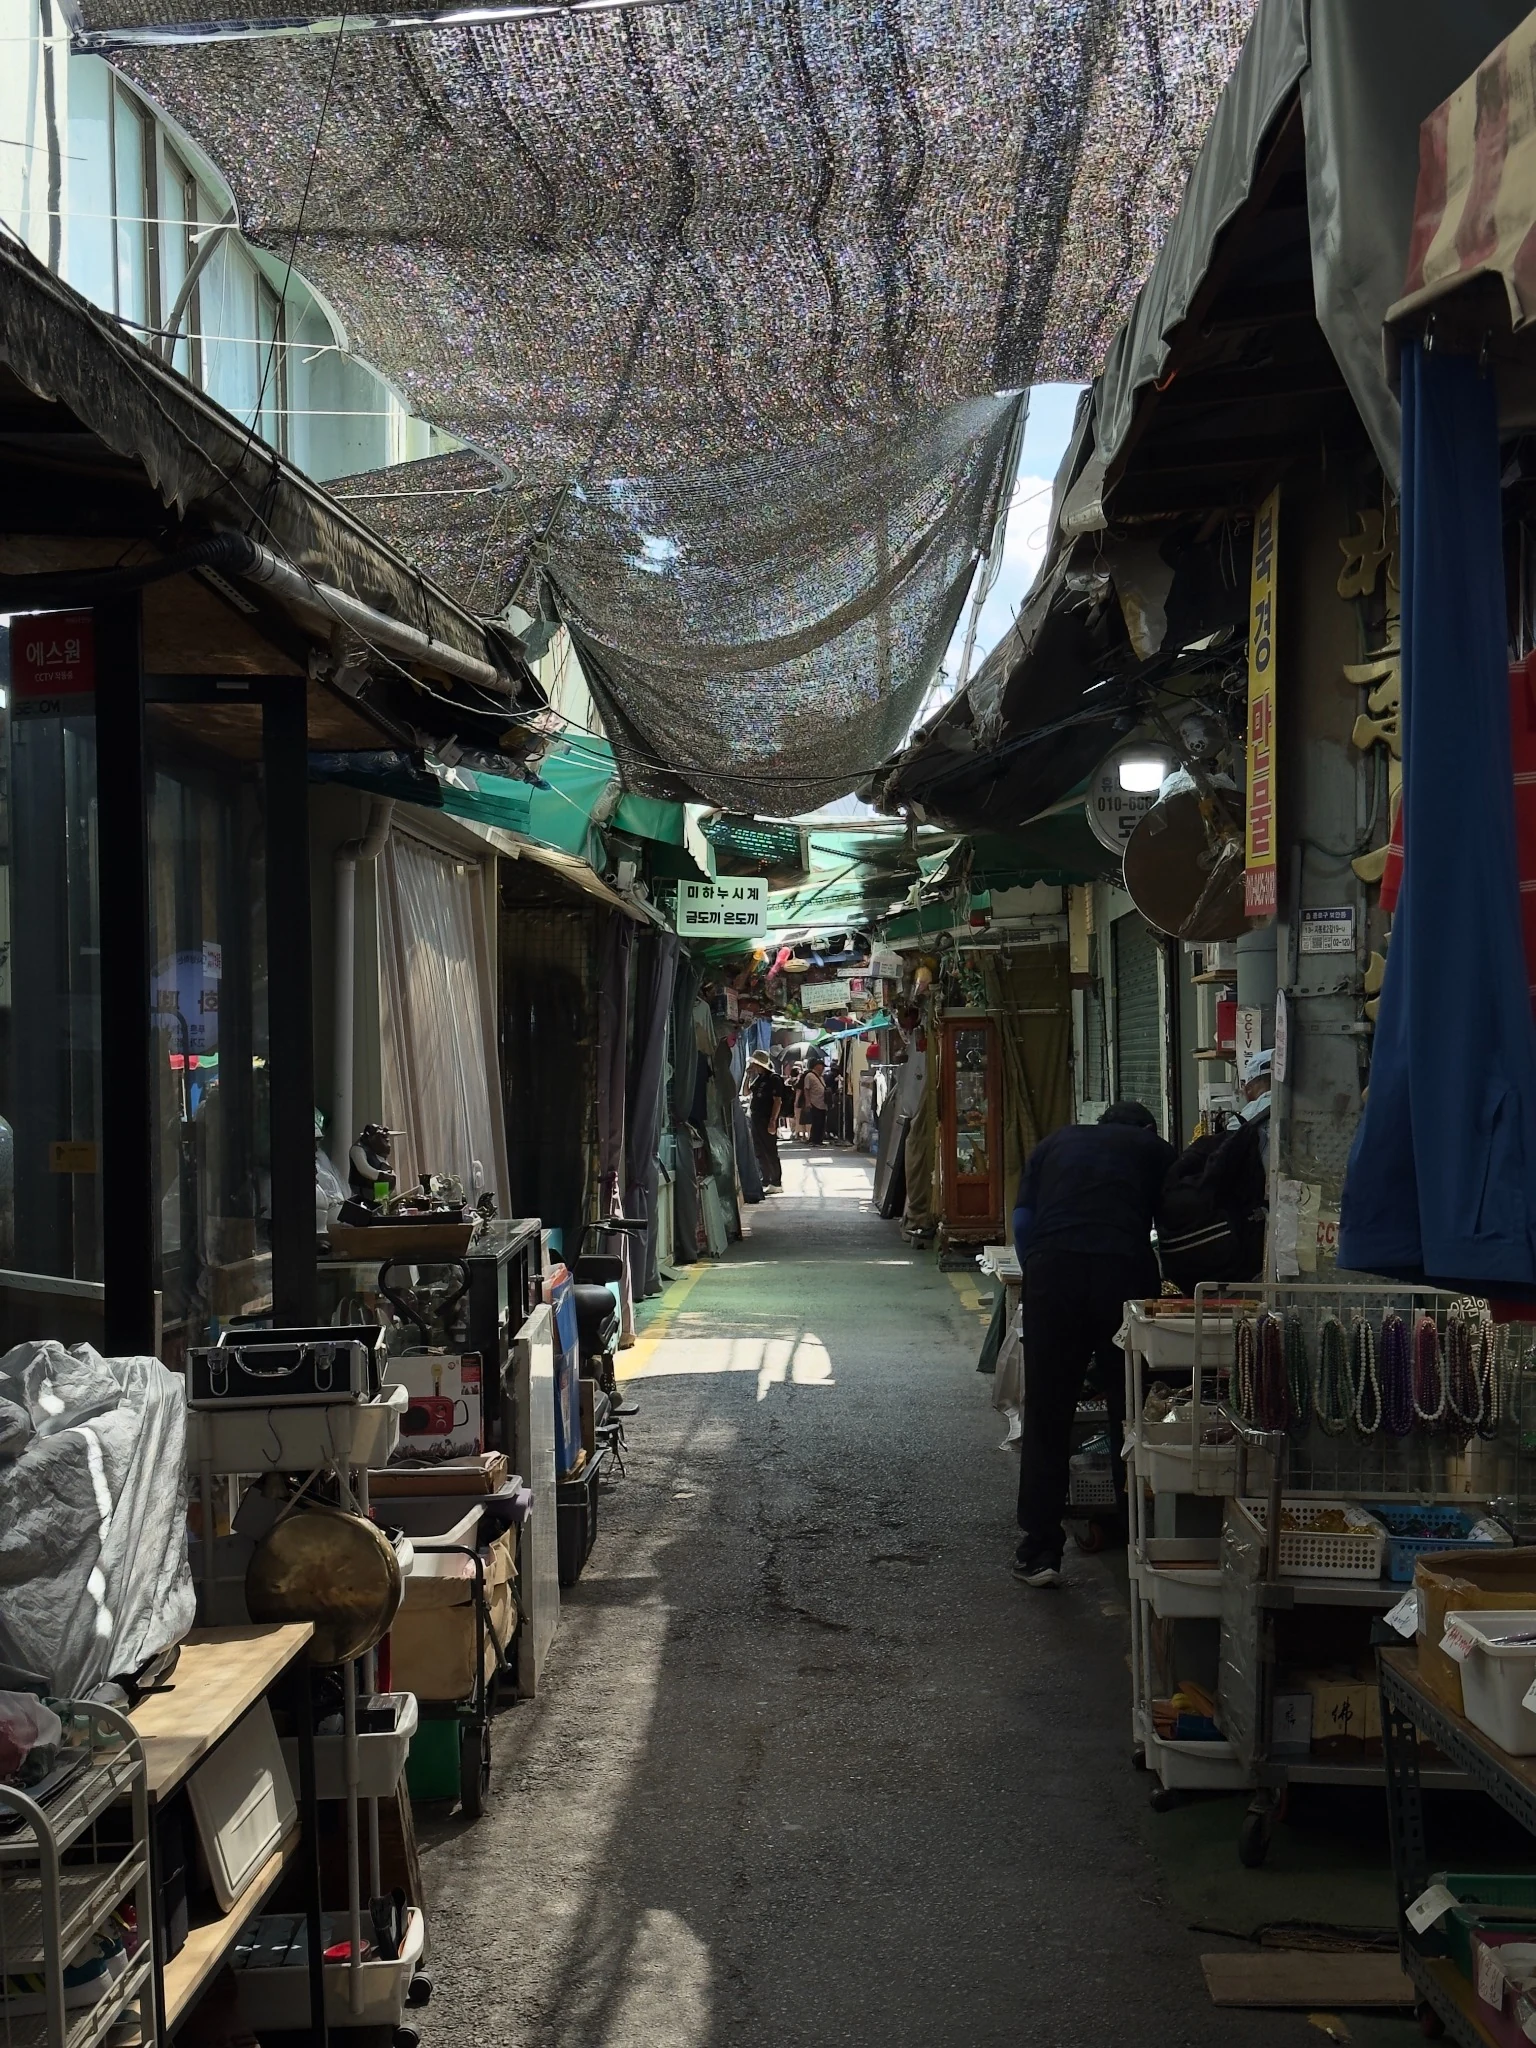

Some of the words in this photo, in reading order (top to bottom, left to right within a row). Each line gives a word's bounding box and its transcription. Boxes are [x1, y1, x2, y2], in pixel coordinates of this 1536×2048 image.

[26, 638, 81, 667] 에스원
[34, 672, 54, 683] CCTV
[15, 699, 60, 715] SEOM
[686, 910, 721, 924] 금도끼
[1332, 938, 1350, 947] 02-120
[1244, 1013, 1253, 1049] CCTV
[1317, 1221, 1340, 1244] CC
[1331, 1695, 1354, 1736] 佛
